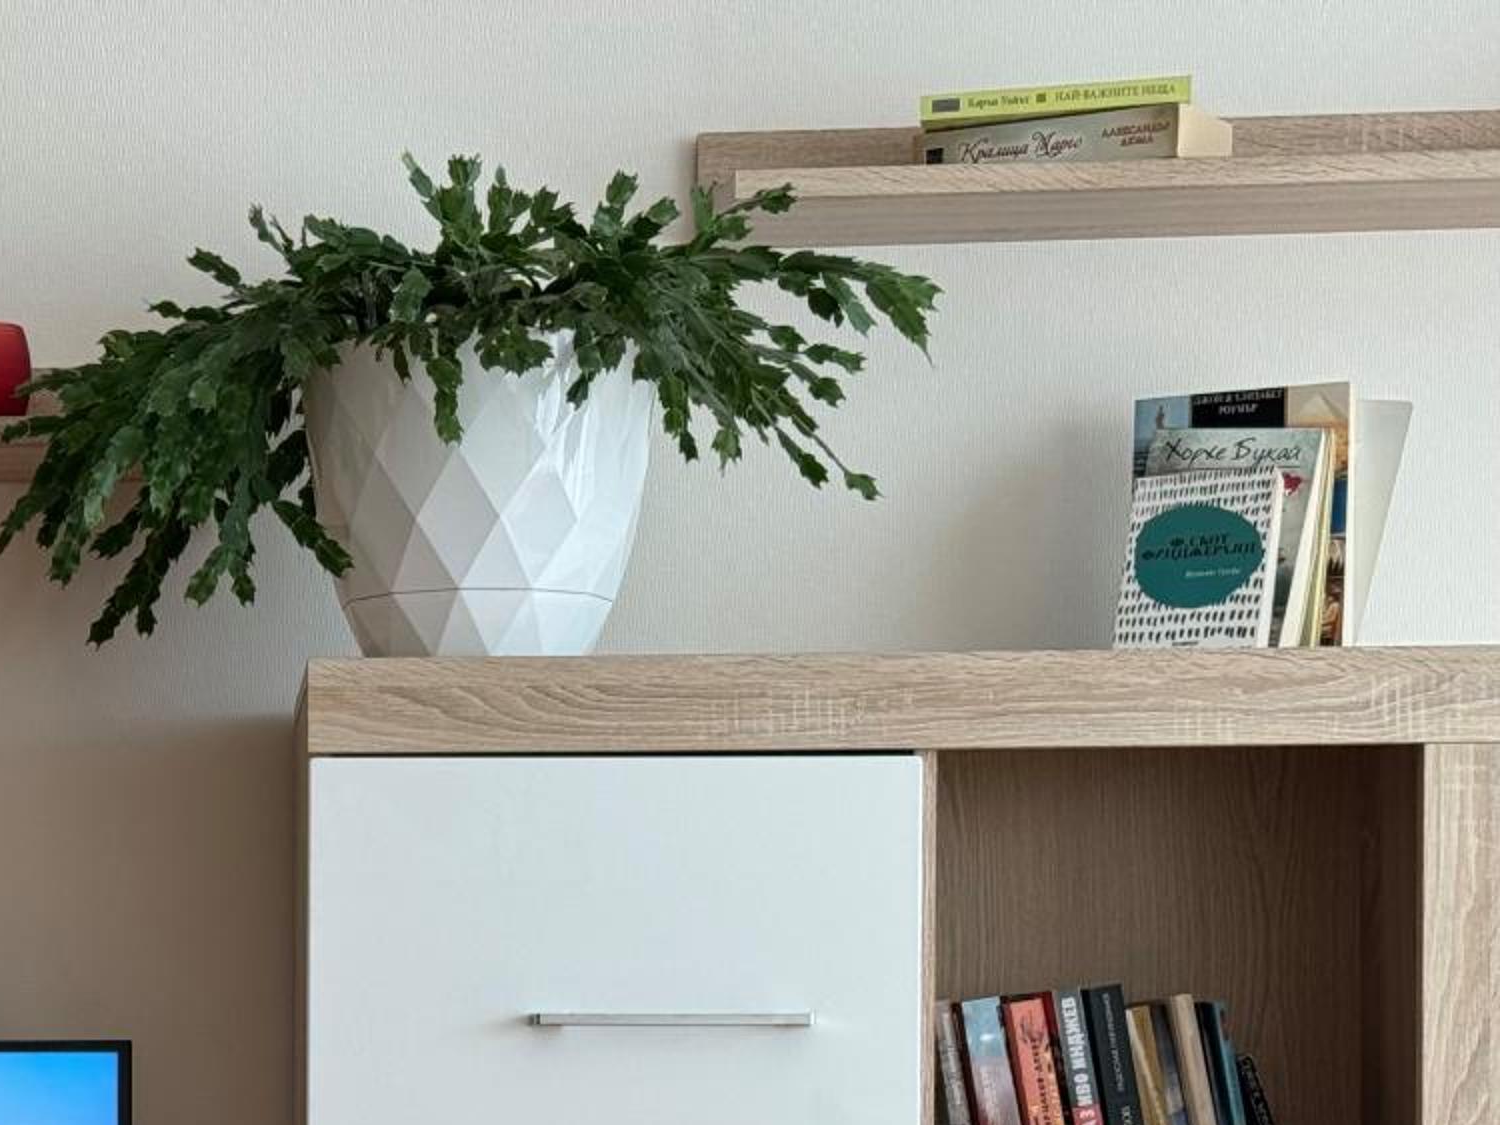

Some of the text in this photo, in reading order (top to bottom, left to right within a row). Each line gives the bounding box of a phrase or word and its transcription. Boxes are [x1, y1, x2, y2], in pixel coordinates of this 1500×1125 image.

[1229, 438, 1301, 467] Букай
[1060, 996, 1092, 1105] ИВО ИНДЖЕВ
